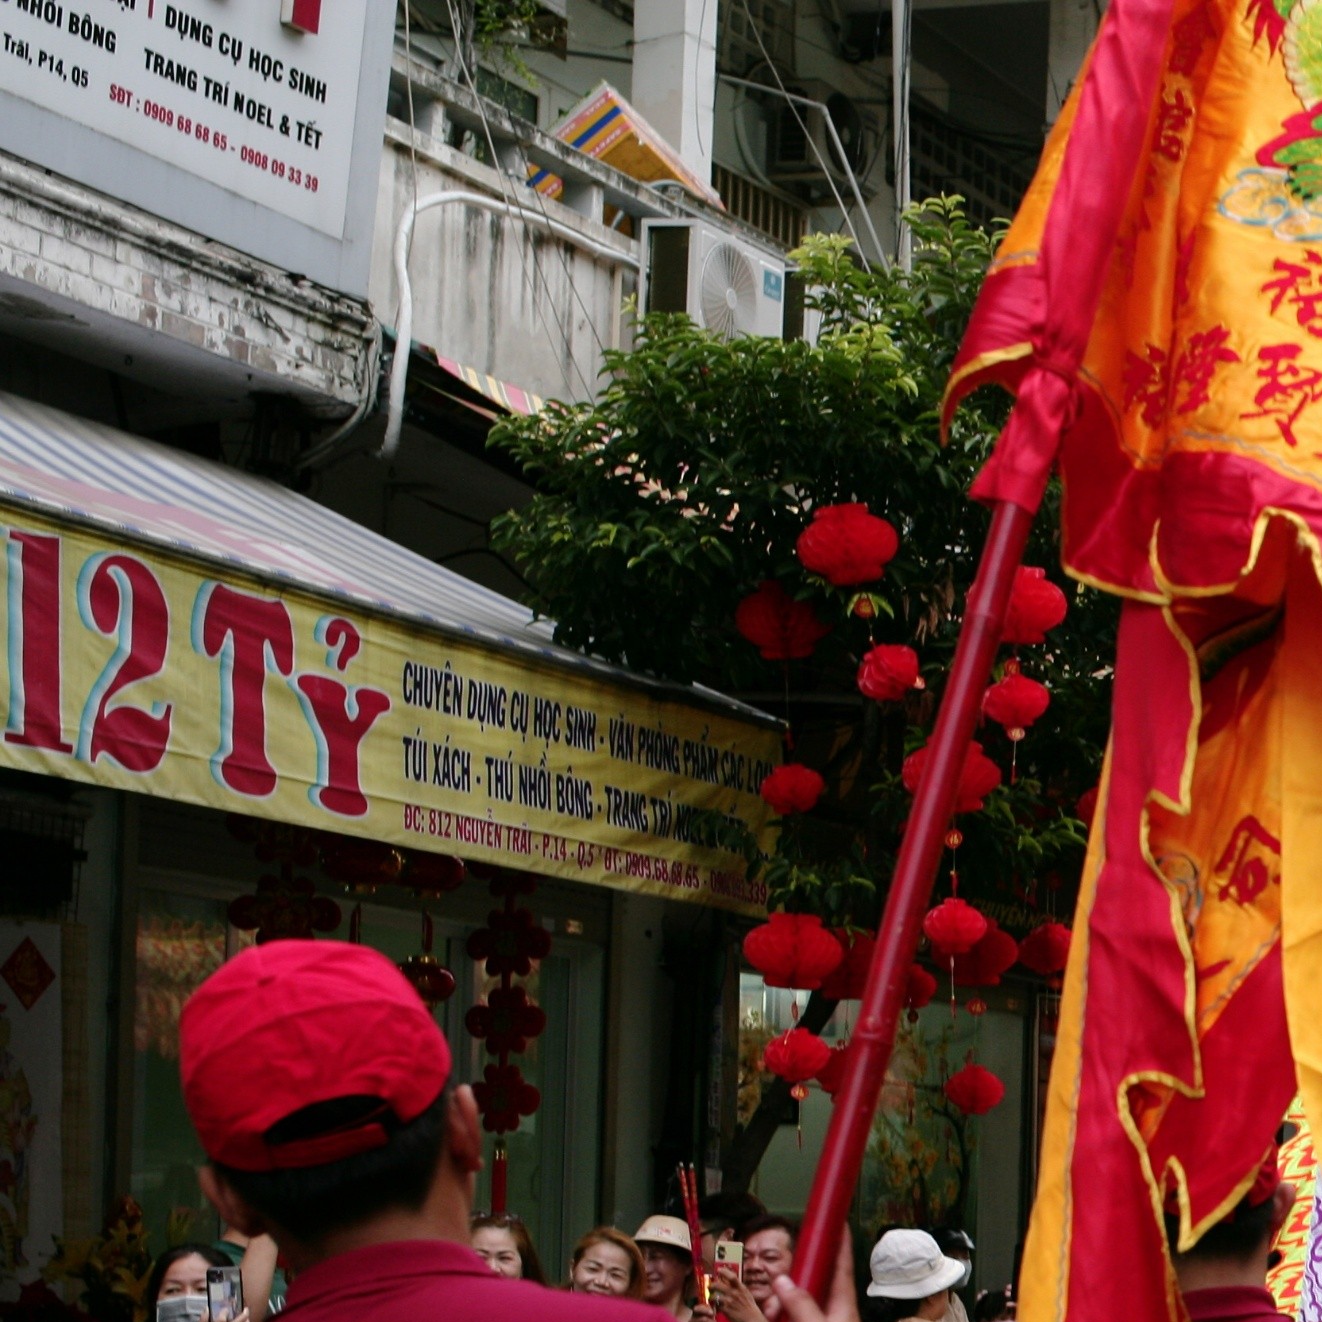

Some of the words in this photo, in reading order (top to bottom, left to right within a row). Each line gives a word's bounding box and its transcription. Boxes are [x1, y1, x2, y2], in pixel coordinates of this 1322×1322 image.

[38, 50, 67, 81] P14,
[71, 68, 89, 88] Q5
[69, 13, 117, 54] BÔNG
[144, 48, 198, 93] TRANG
[203, 76, 230, 107] TRÍ
[233, 92, 274, 129] NOEL
[279, 114, 290, 137] &
[296, 120, 323, 150] TẾT
[165, 5, 213, 48] DỤNG
[218, 32, 243, 62] CỤ
[249, 48, 284, 83] HỌC
[288, 69, 327, 103] SINH
[109, 84, 133, 108] SĐT
[144, 100, 174, 127] 0909
[177, 114, 192, 135] 68
[195, 121, 210, 143] 68
[213, 129, 227, 150] 65
[240, 146, 268, 171] 0908
[271, 157, 286, 177] 09
[288, 164, 303, 185] 33
[305, 171, 319, 193] 39
[4, 527, 173, 773] 12
[191, 577, 392, 817] TỶ
[403, 660, 463, 719] CHUYÊN
[467, 678, 507, 733] DỤNG
[510, 692, 530, 744] CỤ
[534, 697, 562, 749] HỌC
[565, 705, 597, 753] SINH
[608, 713, 634, 762] VĂN
[637, 720, 681, 776] PHÒNG
[683, 725, 718, 782] PHẨM
[403, 728, 428, 783] TÚI
[433, 735, 471, 794] XÁCH
[485, 751, 513, 801] THÚ
[518, 751, 552, 812] NHỒI
[557, 771, 593, 821] BÔNG
[604, 785, 649, 833] TRANG
[650, 790, 672, 835] TRÍ
[404, 805, 425, 833] ĐC:
[429, 813, 451, 839] 812
[456, 809, 502, 849] NGUYỄN
[542, 839, 567, 861] P.14
[578, 842, 594, 869] Q.5
[625, 851, 699, 889] 0909.68.68.65
